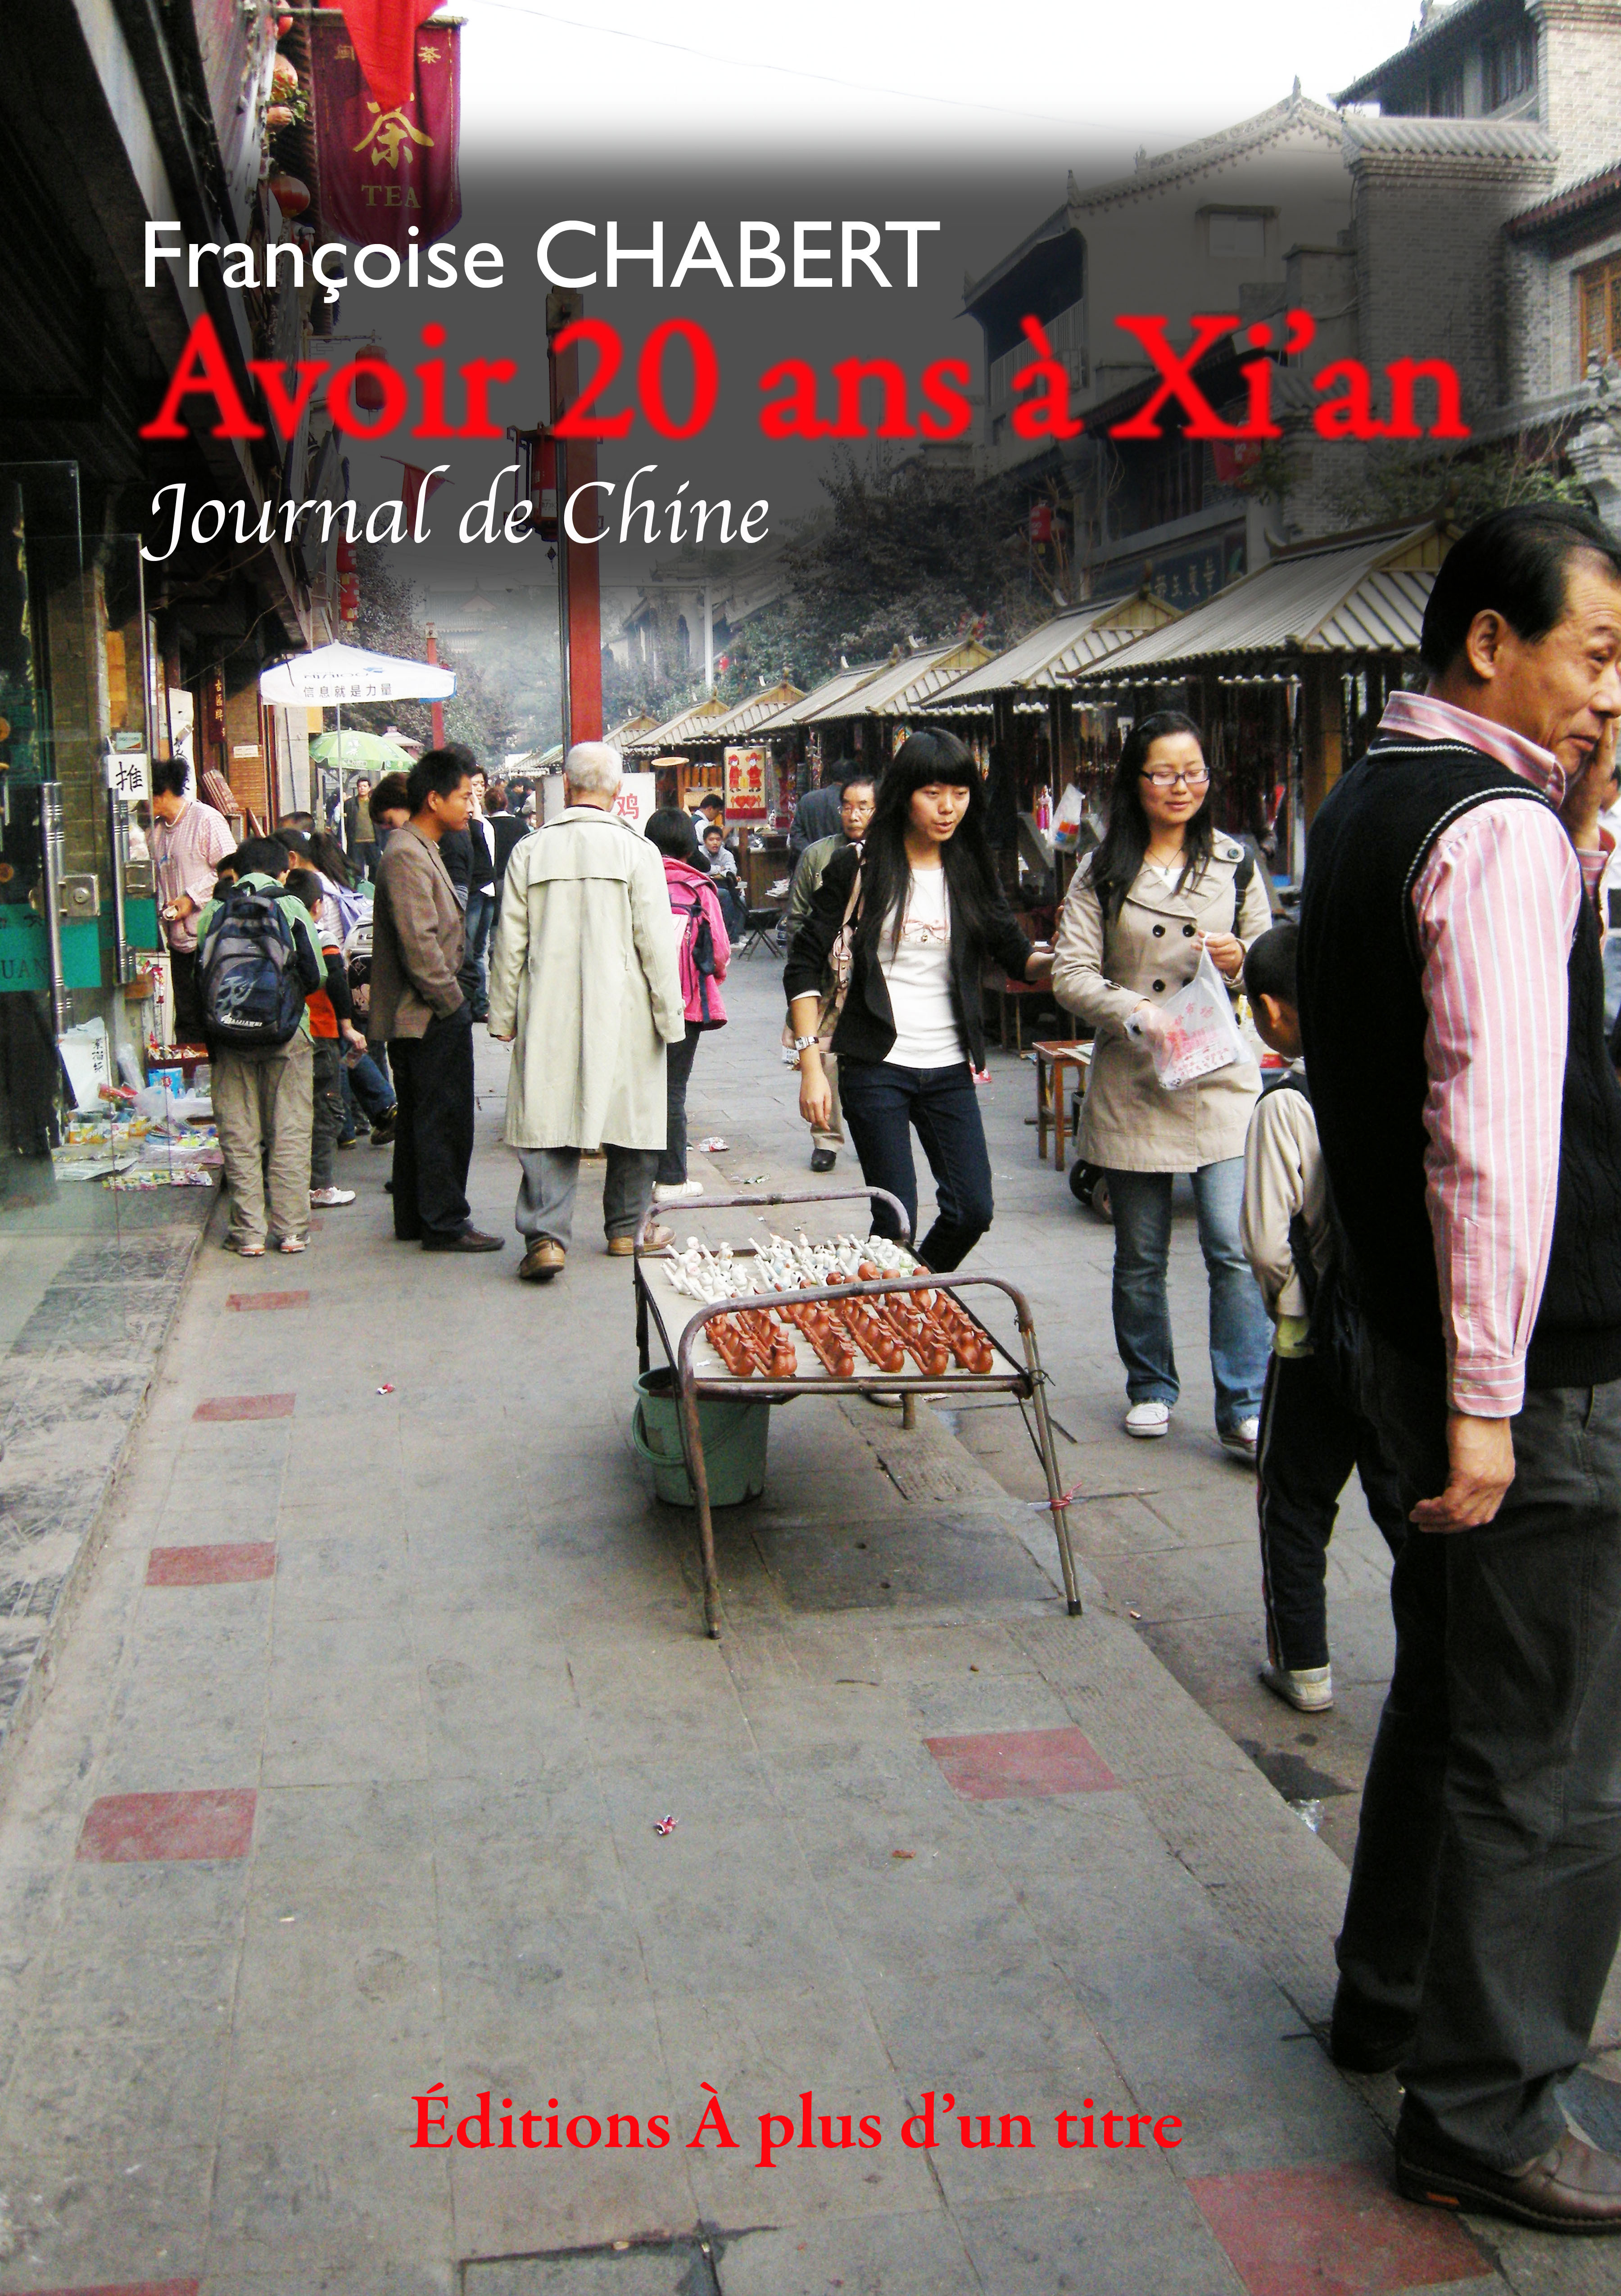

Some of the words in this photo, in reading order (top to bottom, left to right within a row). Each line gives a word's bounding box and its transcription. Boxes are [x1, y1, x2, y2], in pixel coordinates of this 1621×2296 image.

[361, 185, 421, 208] TEA
[303, 683, 392, 698] 信息就是力量
[115, 761, 143, 792] 推
[615, 793, 639, 820] 鸡
